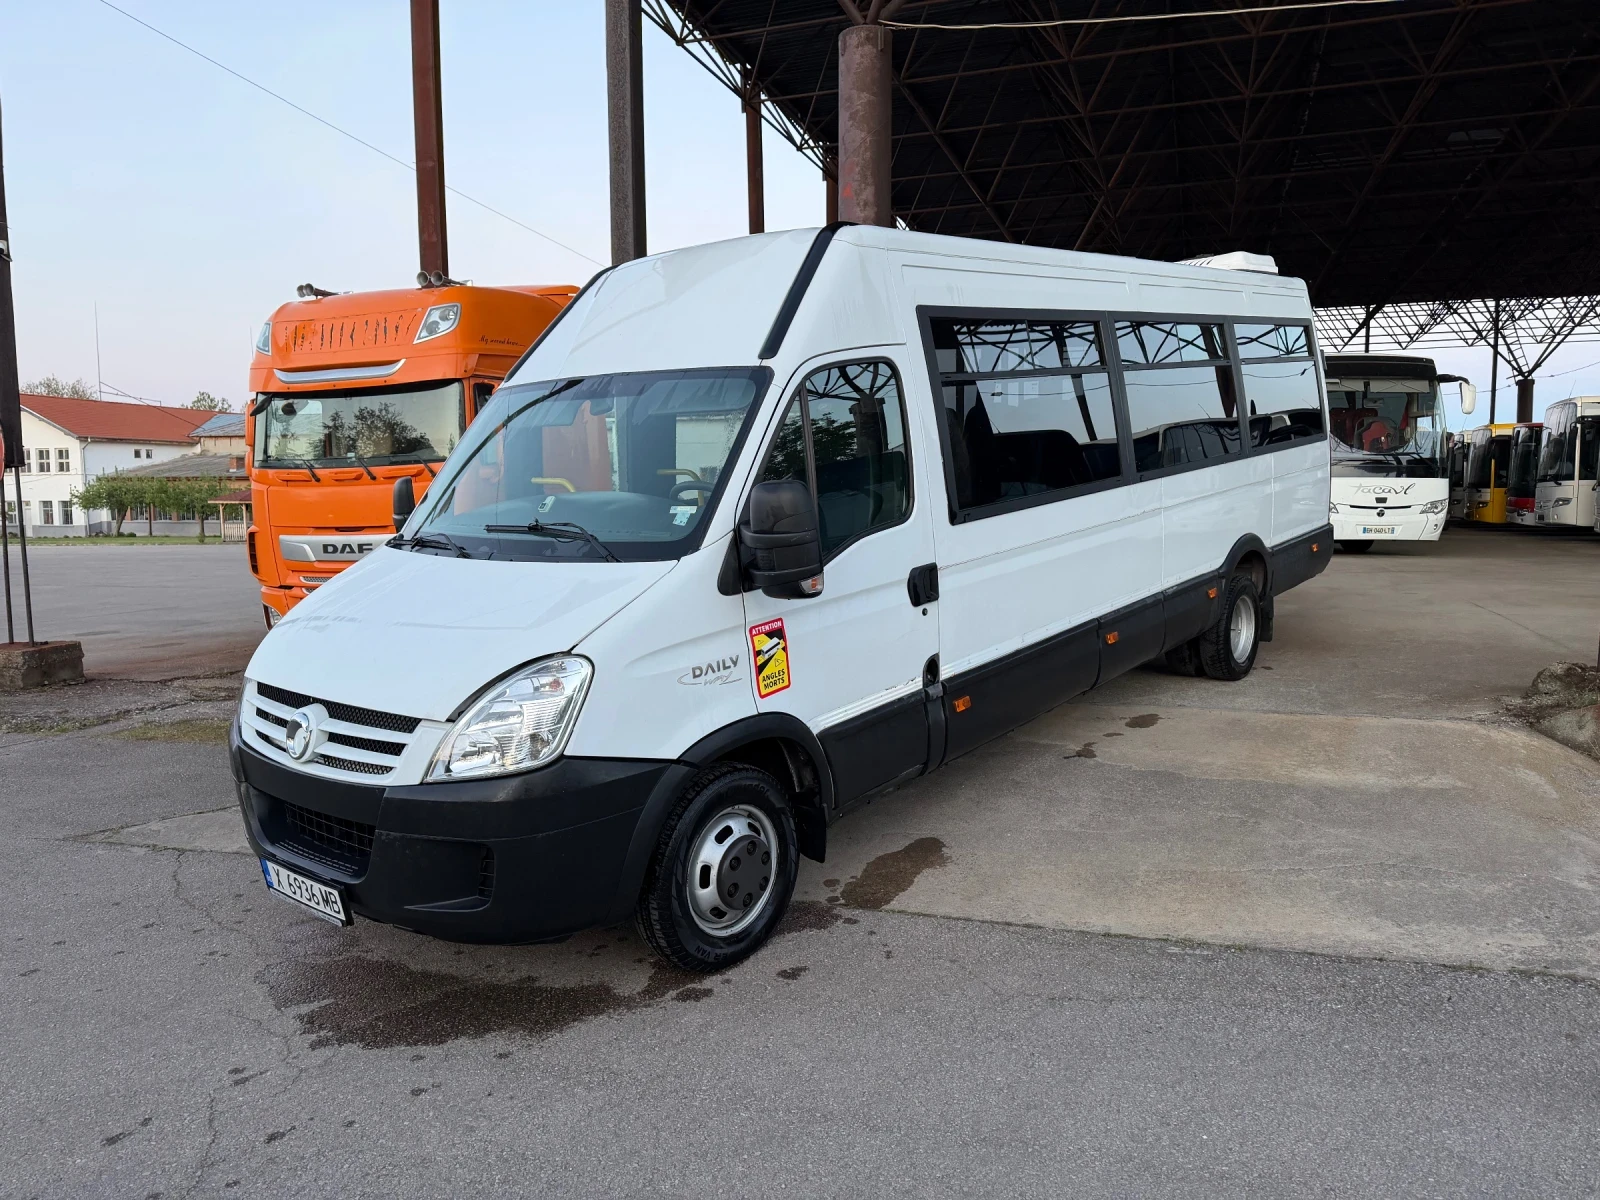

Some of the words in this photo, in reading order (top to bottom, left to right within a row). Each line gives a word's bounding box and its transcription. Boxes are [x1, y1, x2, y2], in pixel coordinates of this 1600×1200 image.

[322, 543, 374, 554] DAF
[752, 620, 783, 636] ATTENTION
[691, 654, 740, 680] DAILY
[762, 668, 786, 684] ANGLES
[764, 676, 786, 691] MORTS
[272, 866, 285, 890] X
[287, 873, 320, 906] 6936
